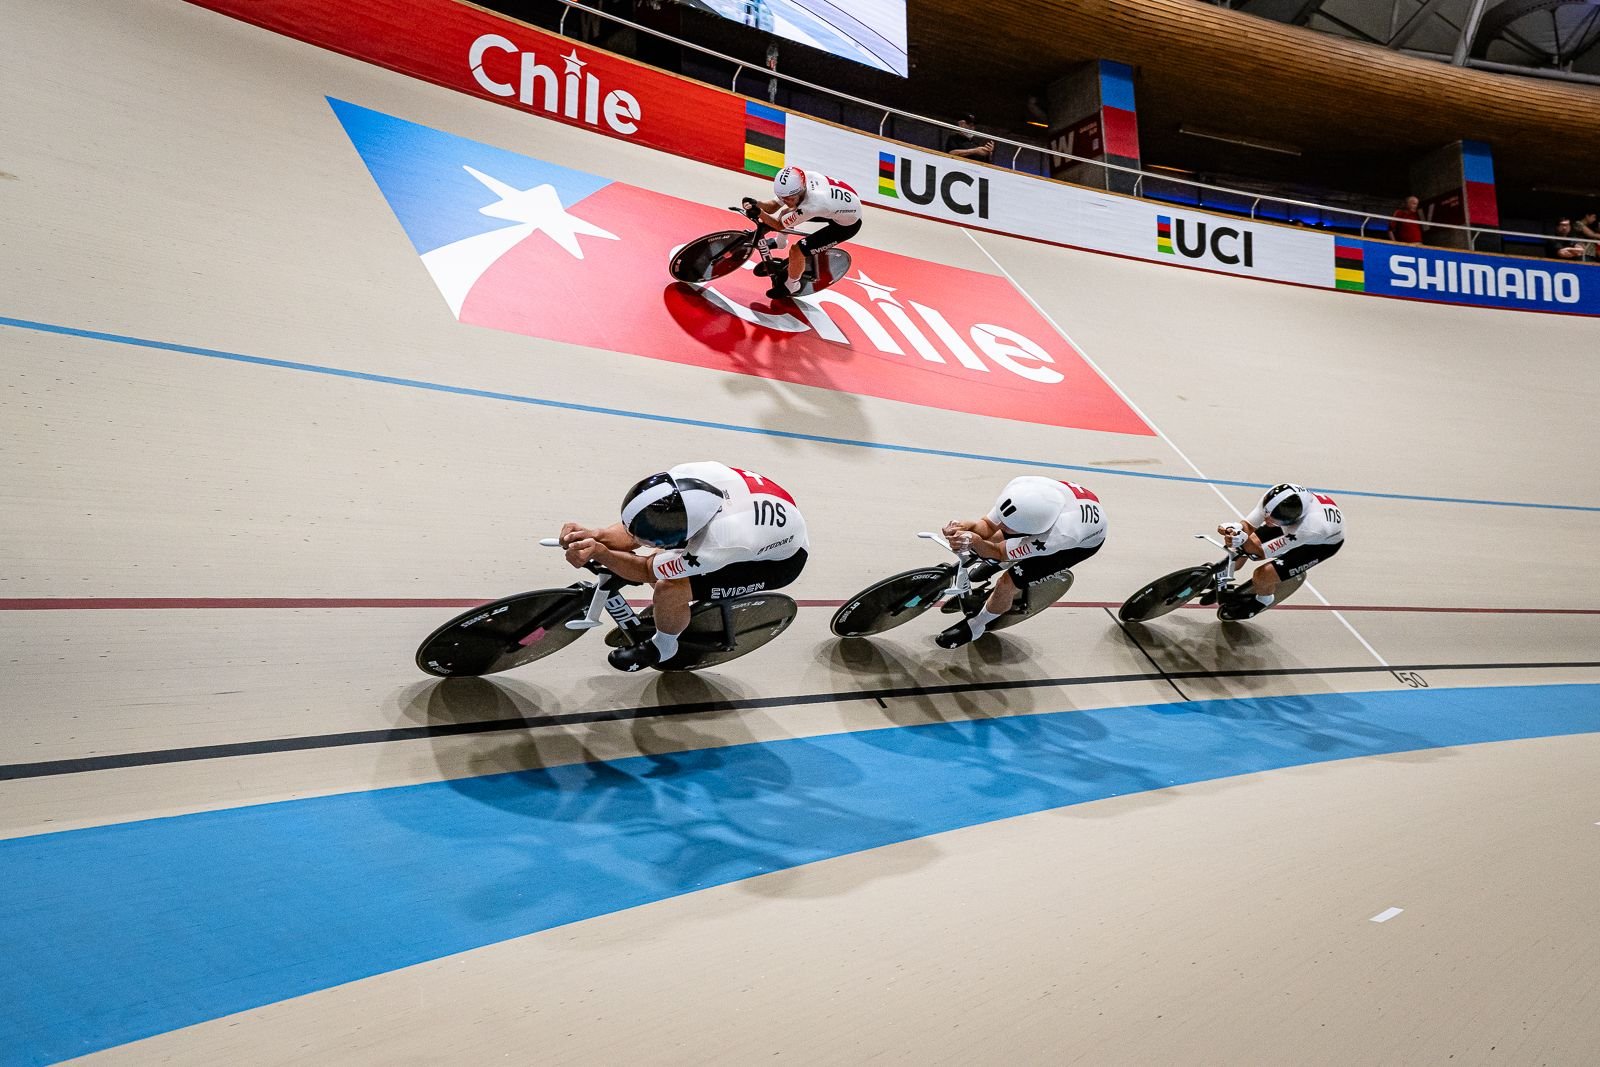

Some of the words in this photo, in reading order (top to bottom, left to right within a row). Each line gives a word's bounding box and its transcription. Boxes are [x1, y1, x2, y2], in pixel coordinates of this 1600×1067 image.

[468, 34, 642, 136] Chile
[900, 157, 990, 220] UCI
[1174, 218, 1254, 268] UCI
[1388, 253, 1581, 304] SHIMANO
[753, 499, 787, 528] SUI
[1079, 504, 1100, 525] SUI
[1288, 558, 1319, 577] EVIDEN
[710, 581, 766, 600] EVIDEN
[605, 594, 642, 630] BMC
